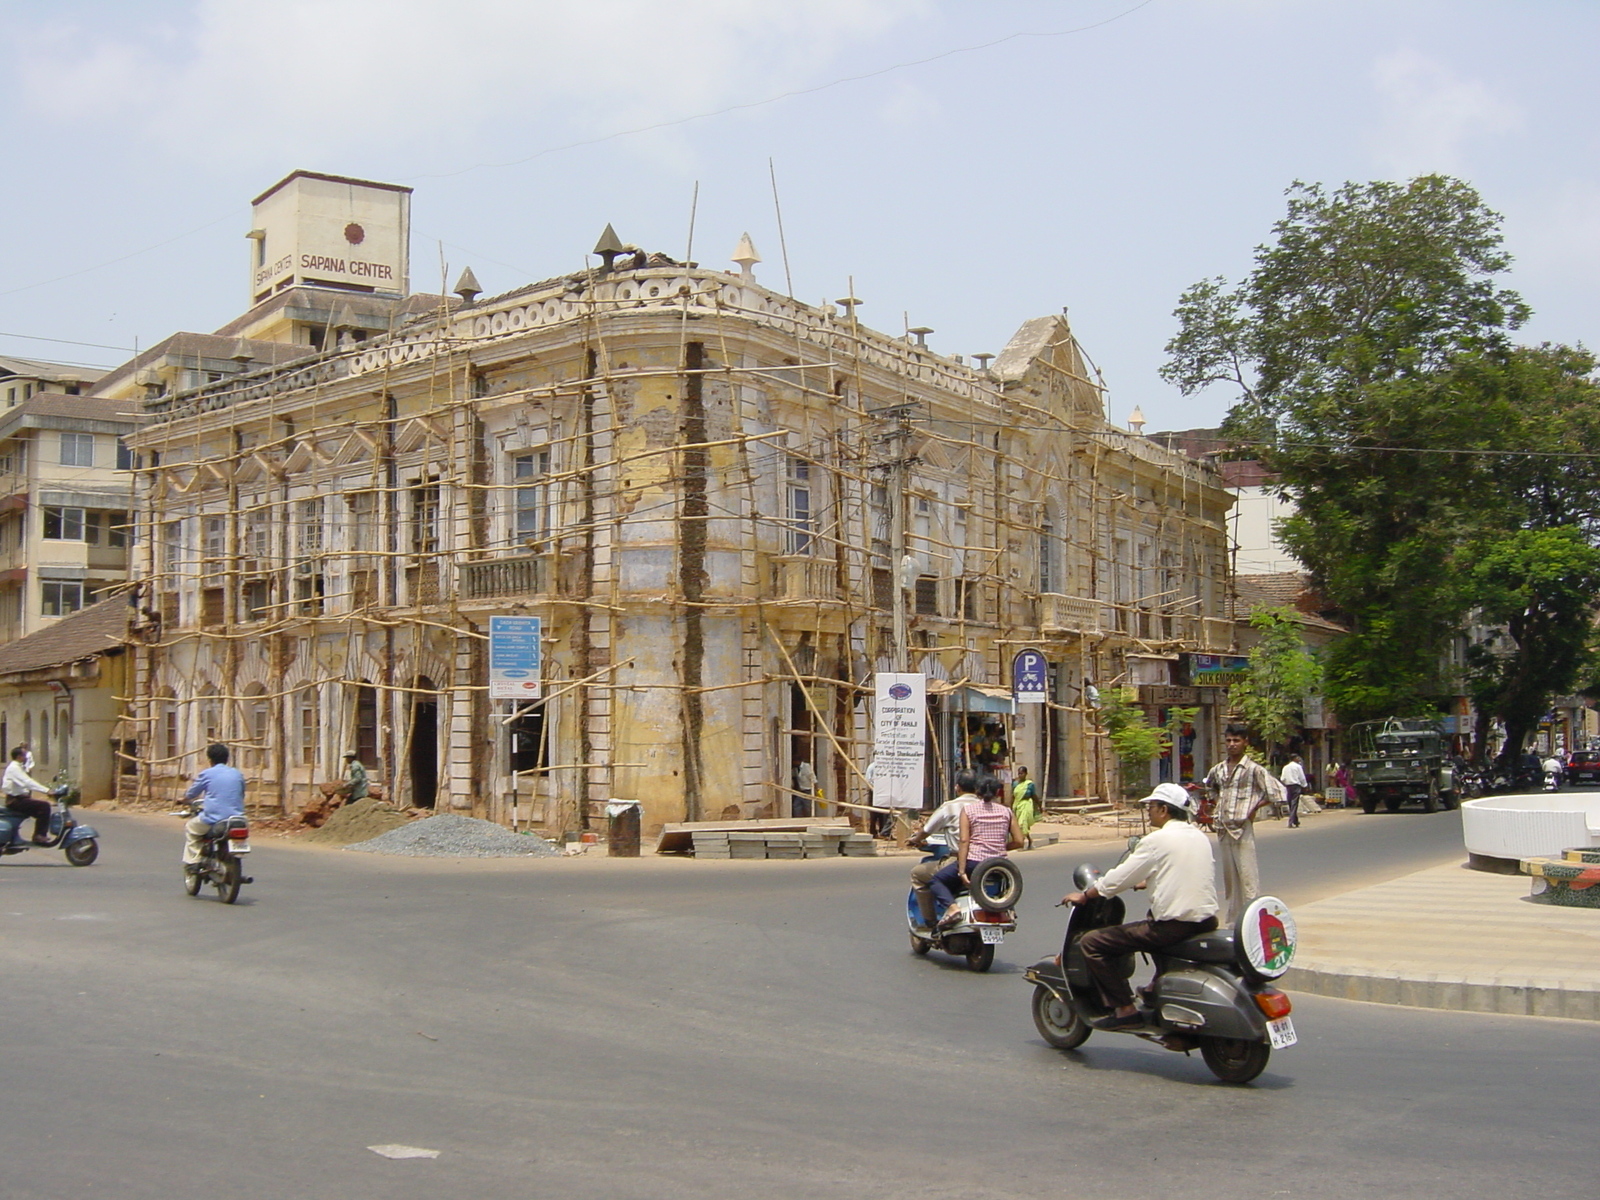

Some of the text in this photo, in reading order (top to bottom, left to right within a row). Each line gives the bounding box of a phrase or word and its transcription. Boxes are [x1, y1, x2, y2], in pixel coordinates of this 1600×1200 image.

[301, 254, 392, 280] SAPANA CENTER
[1025, 655, 1037, 671] P
[1199, 673, 1214, 684] SILK
[1274, 950, 1286, 968] 2T
